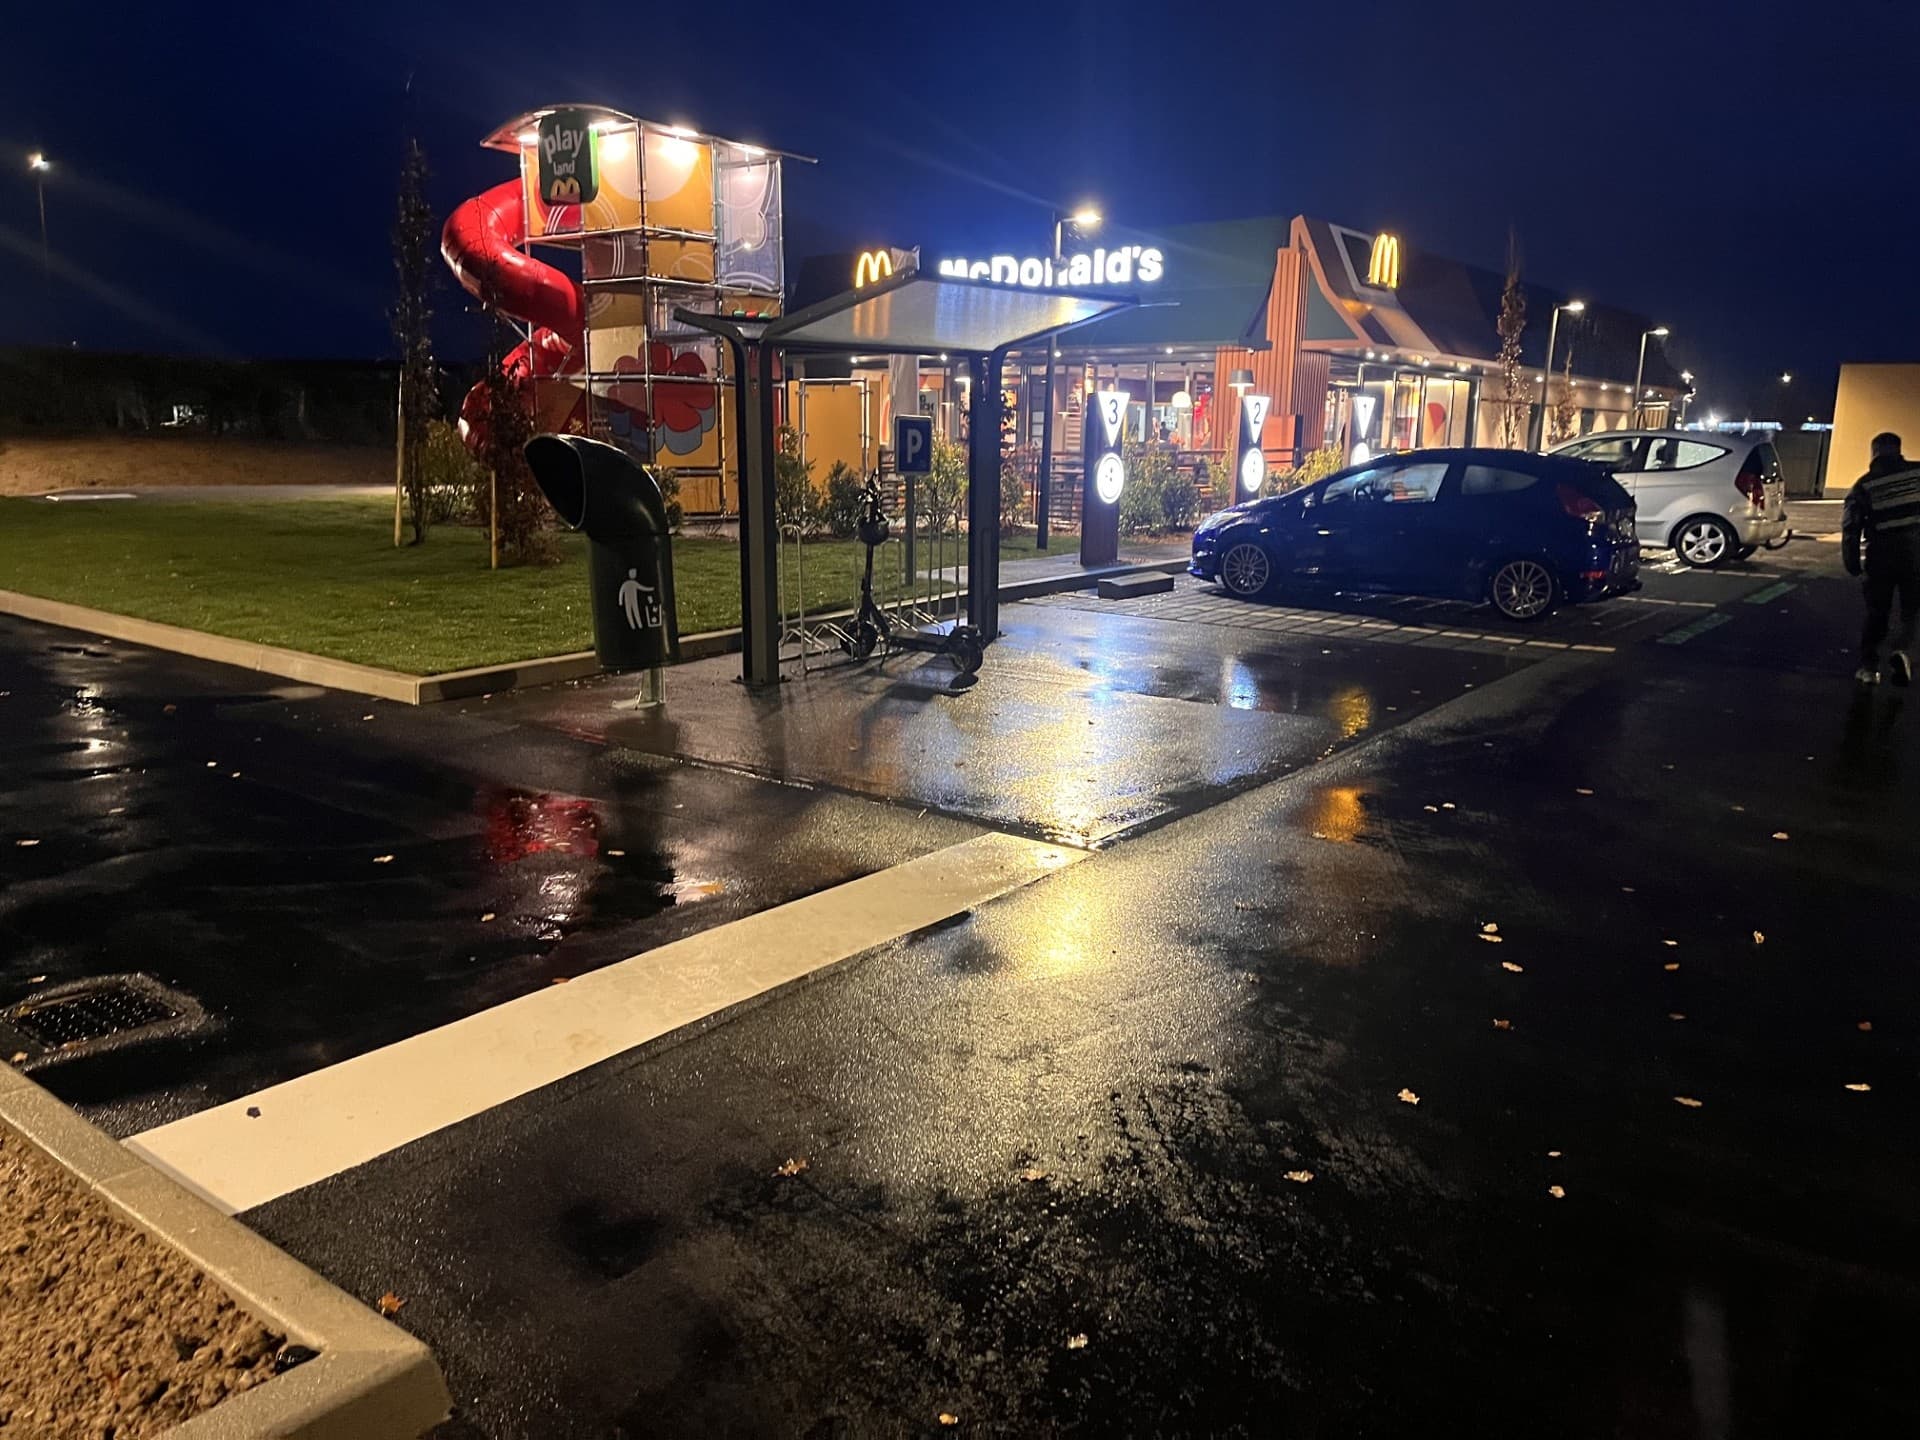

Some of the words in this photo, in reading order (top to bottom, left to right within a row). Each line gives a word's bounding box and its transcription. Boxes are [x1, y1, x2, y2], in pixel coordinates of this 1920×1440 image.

[544, 125, 583, 164] play
[553, 160, 575, 176] land
[1108, 398, 1119, 425] 3
[1253, 402, 1261, 425] 2
[907, 429, 922, 464] P
